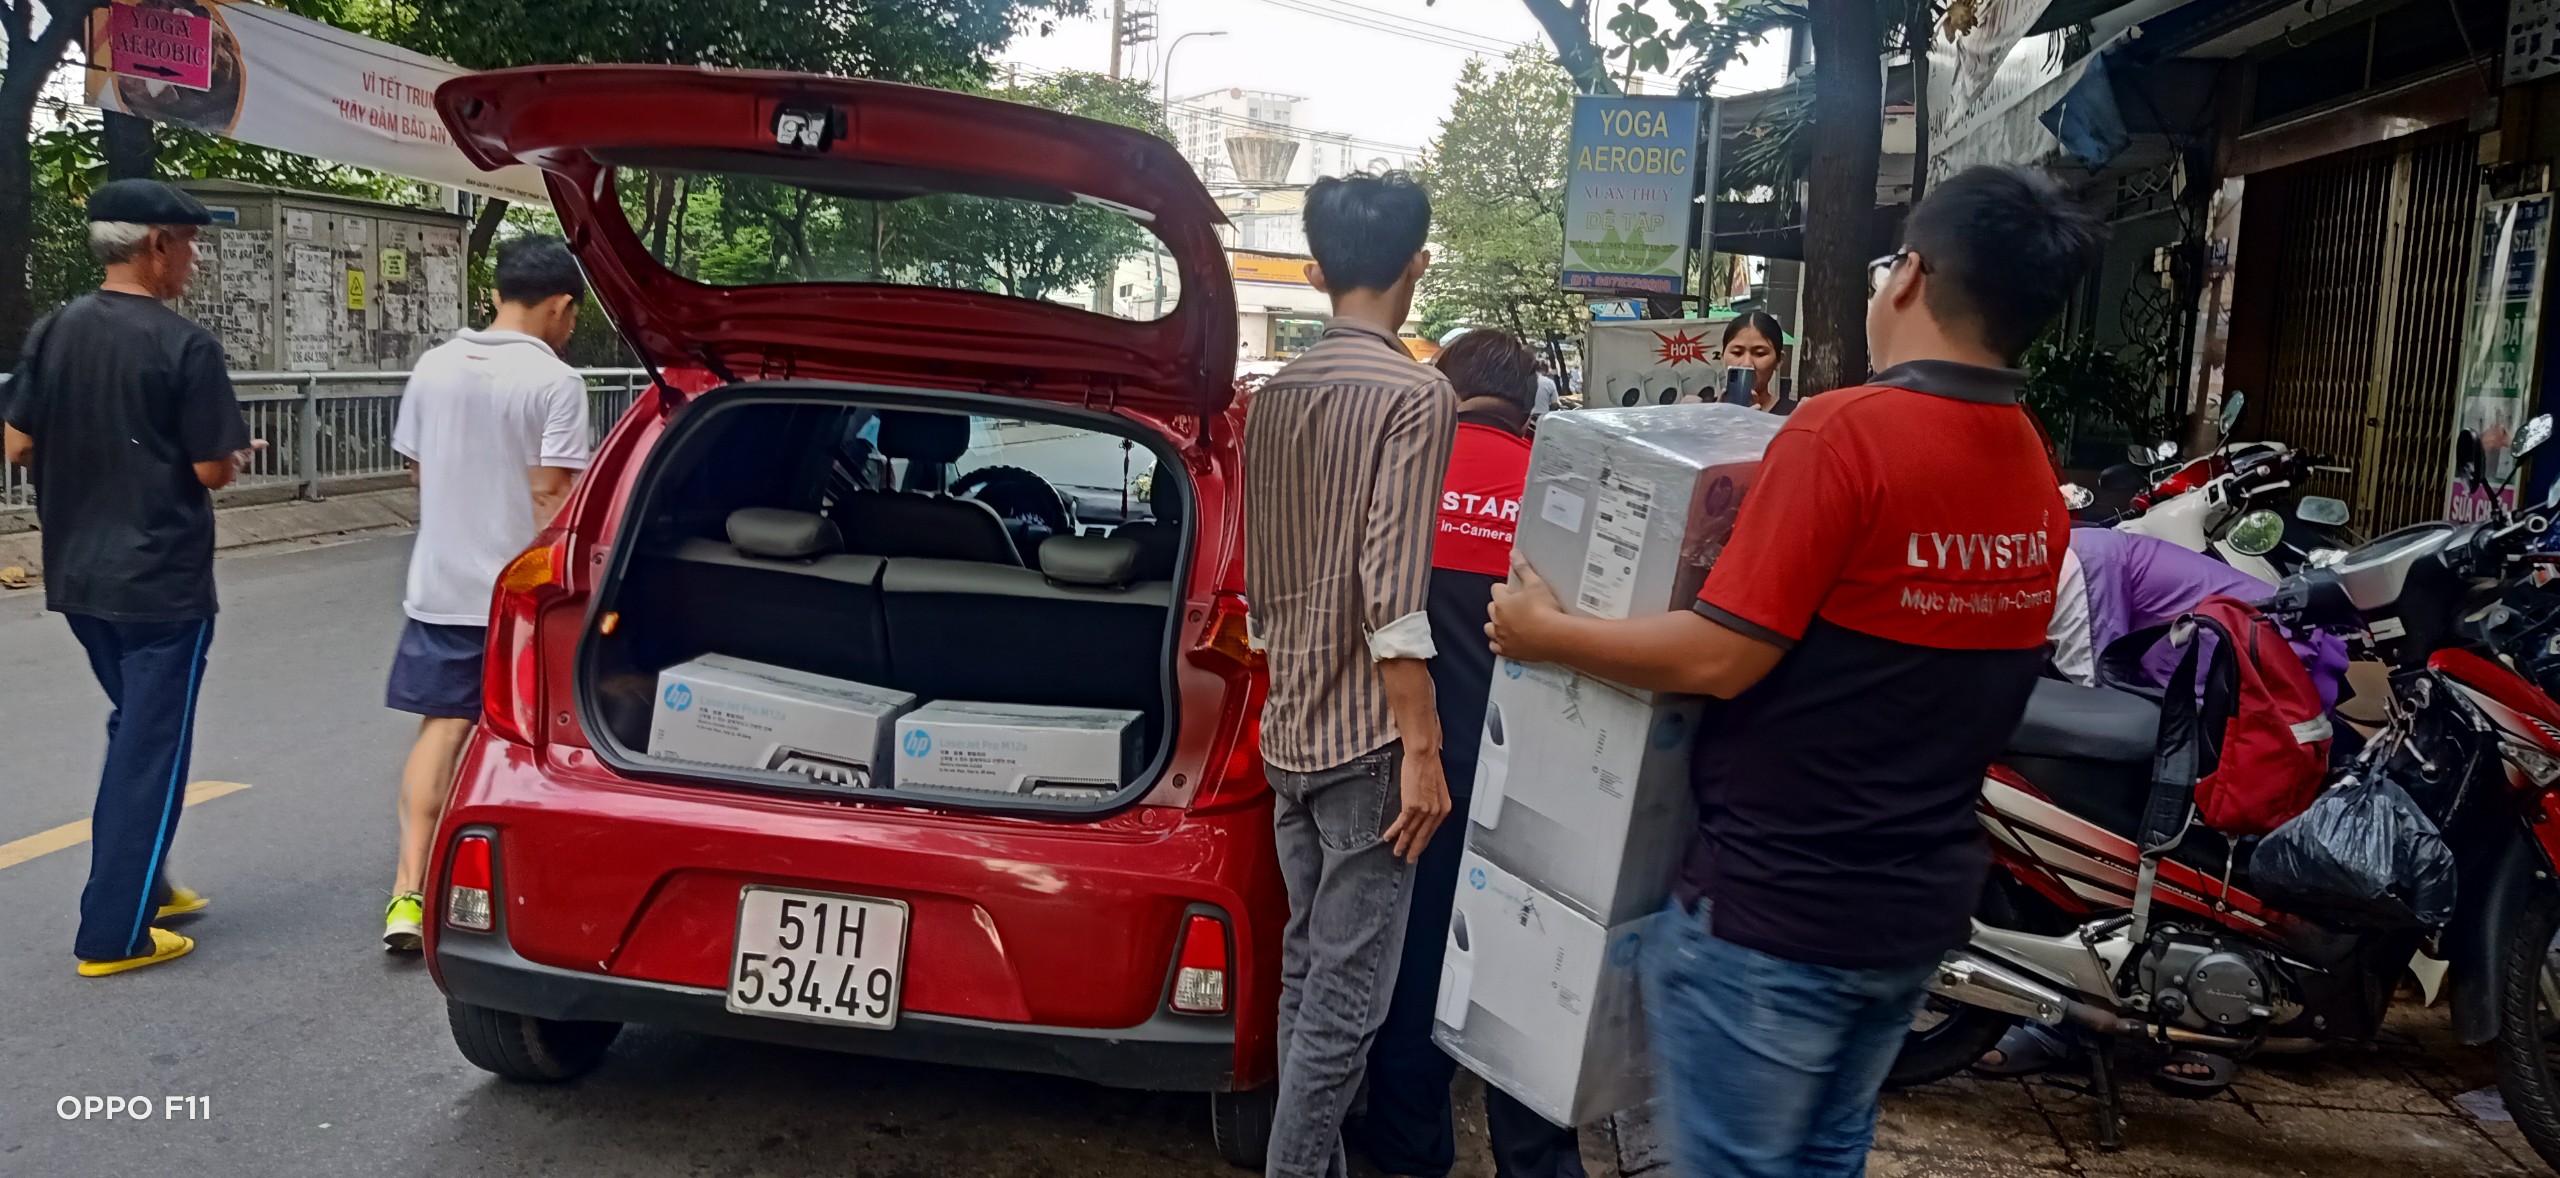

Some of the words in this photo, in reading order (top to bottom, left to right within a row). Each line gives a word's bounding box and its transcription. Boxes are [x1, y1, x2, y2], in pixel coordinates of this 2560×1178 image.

[131, 9, 191, 38] YOGA
[116, 31, 206, 67] AEROBIC
[363, 71, 375, 94] VÌ
[379, 76, 401, 101] TẾT
[405, 85, 436, 110] TRUN
[369, 105, 397, 132] ĐẢM
[402, 113, 427, 139] BẢO
[1600, 109, 1668, 138] YOGA
[1576, 145, 1687, 175] AEROBIC
[1670, 343, 1696, 357] HOT
[1442, 491, 1520, 522] STAR
[1907, 531, 2048, 570] LYVYSTAR
[903, 729, 931, 758] hp
[778, 898, 867, 958] 51H
[737, 952, 893, 1019] 534.49
